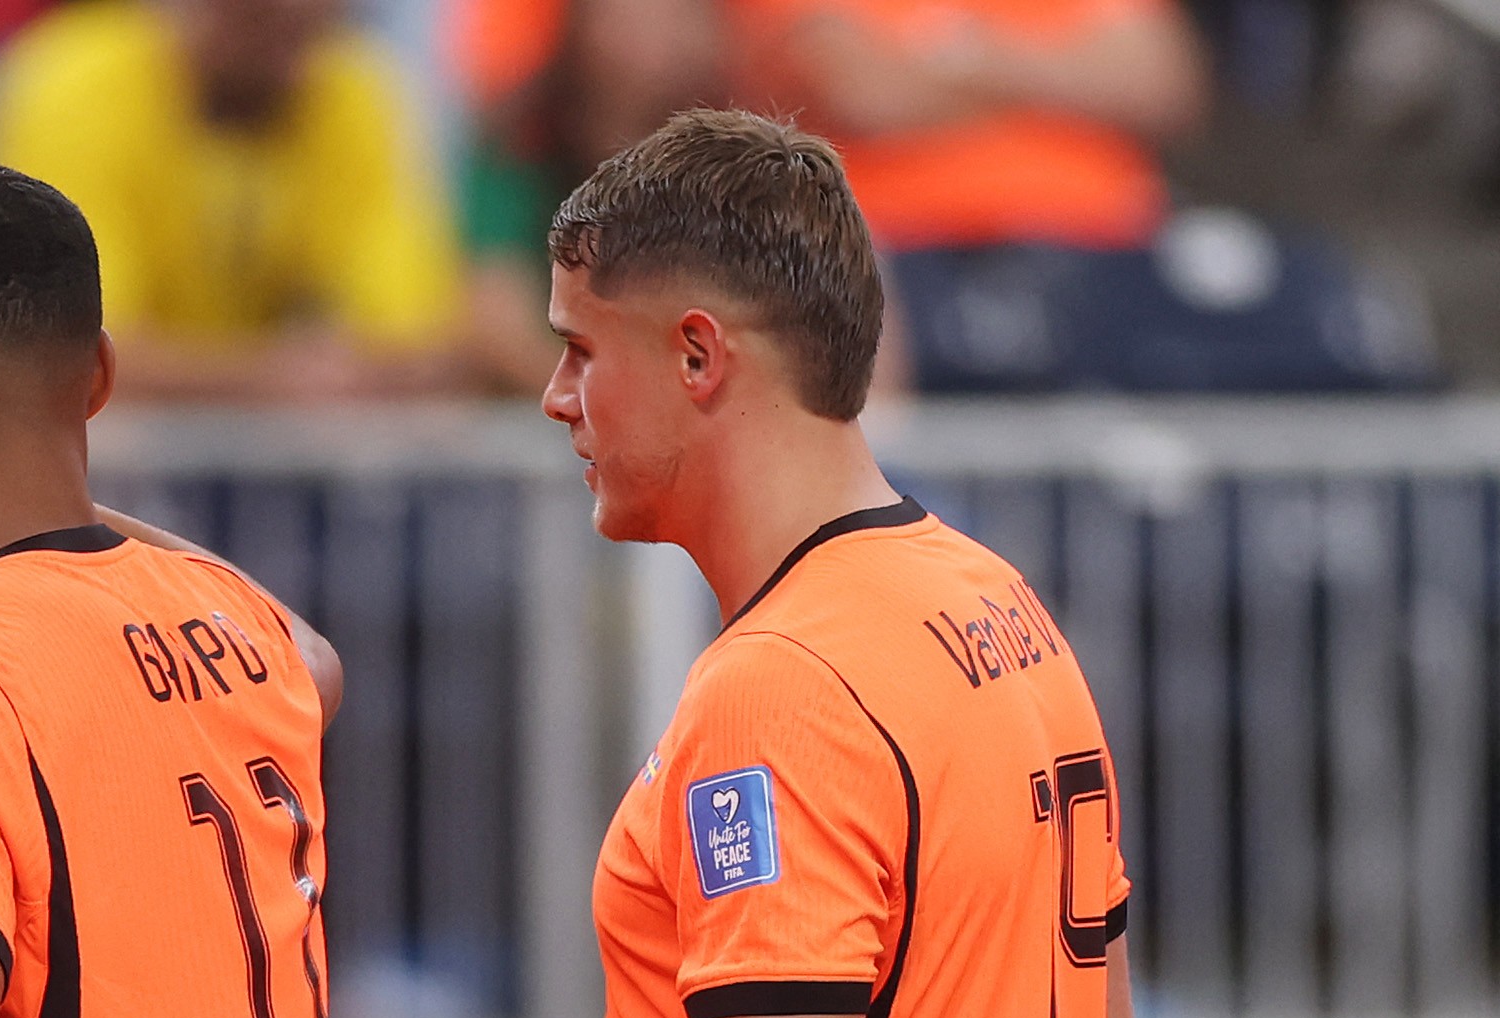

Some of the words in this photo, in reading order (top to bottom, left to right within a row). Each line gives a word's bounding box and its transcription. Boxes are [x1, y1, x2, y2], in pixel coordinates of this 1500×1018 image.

[123, 609, 267, 703] GAPO
[734, 820, 751, 842] For
[713, 841, 752, 870] PEACE
[723, 866, 745, 881] FIFA
